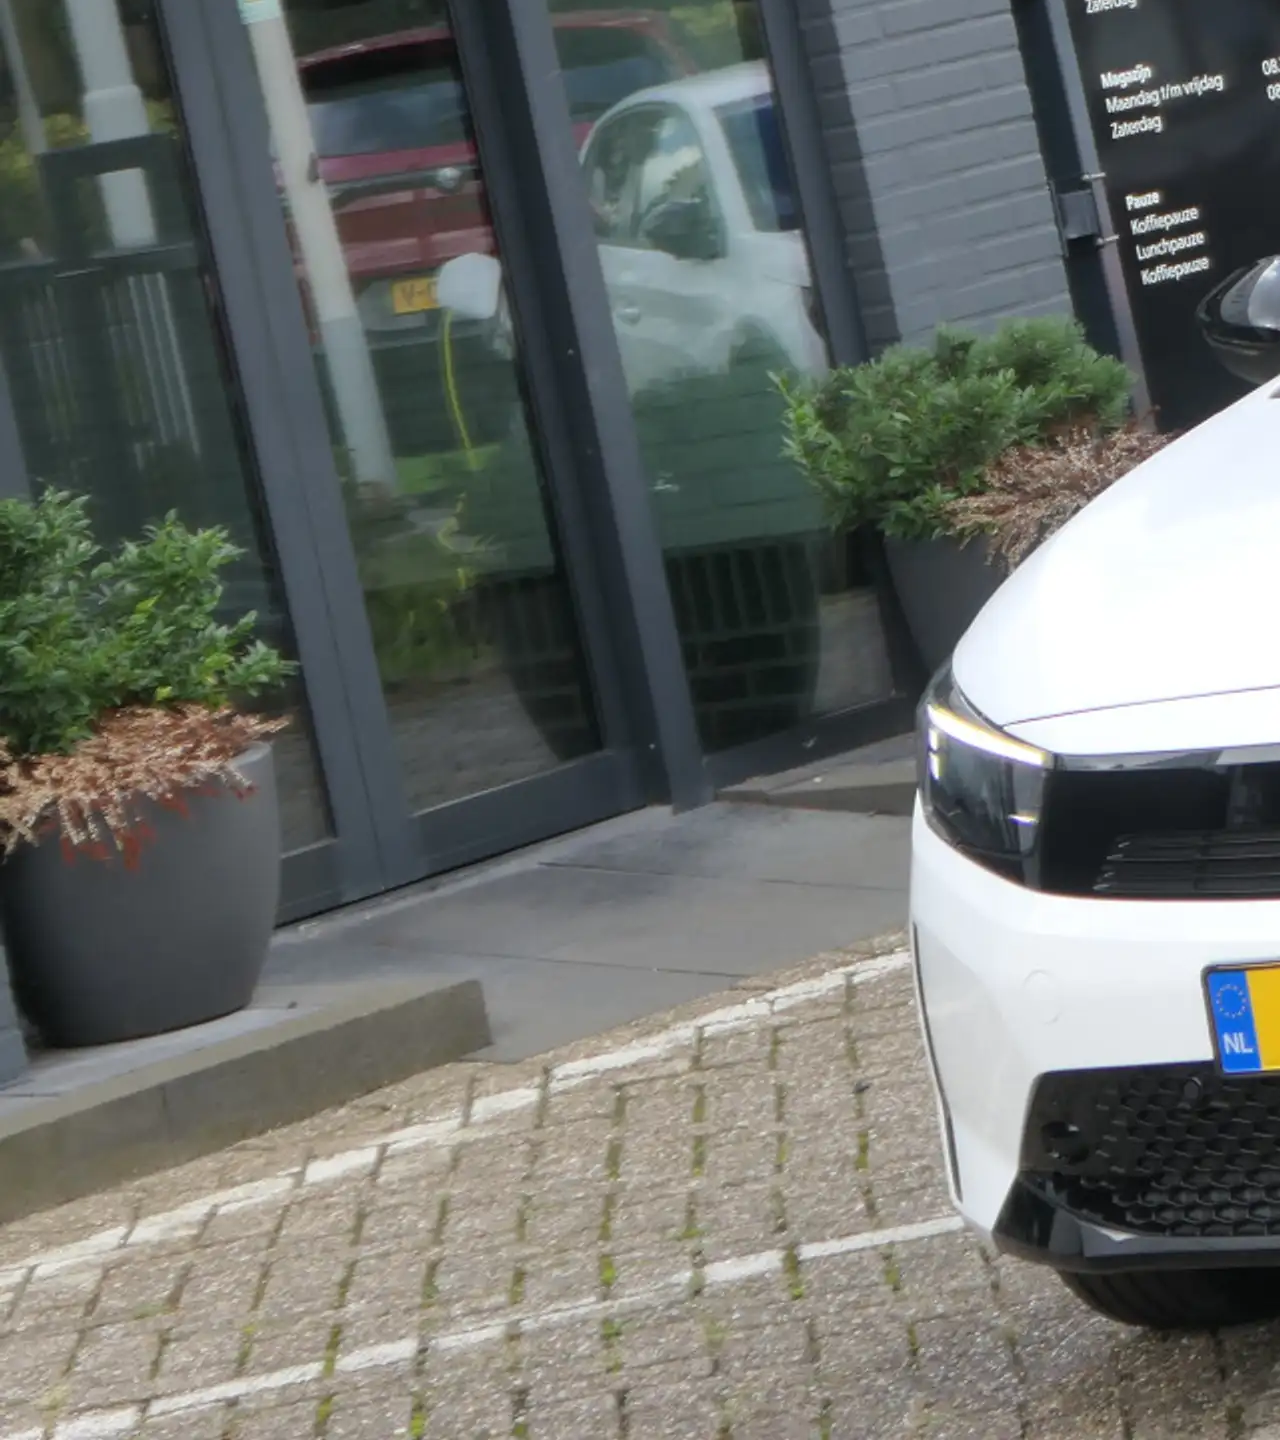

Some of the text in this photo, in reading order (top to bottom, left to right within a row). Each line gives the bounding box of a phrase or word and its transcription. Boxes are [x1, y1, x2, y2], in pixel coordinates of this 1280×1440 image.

[1100, 64, 1152, 89] Magazijn
[1105, 74, 1224, 113] Maandag t/m vrijdag
[1110, 115, 1162, 140] Zaterdag
[1125, 192, 1160, 211] Pauze
[1130, 207, 1199, 235] Koffiepauze
[1136, 231, 1204, 261] Lunchpauze
[1141, 256, 1209, 285] Koffiepauze
[1223, 1032, 1254, 1054] NL
